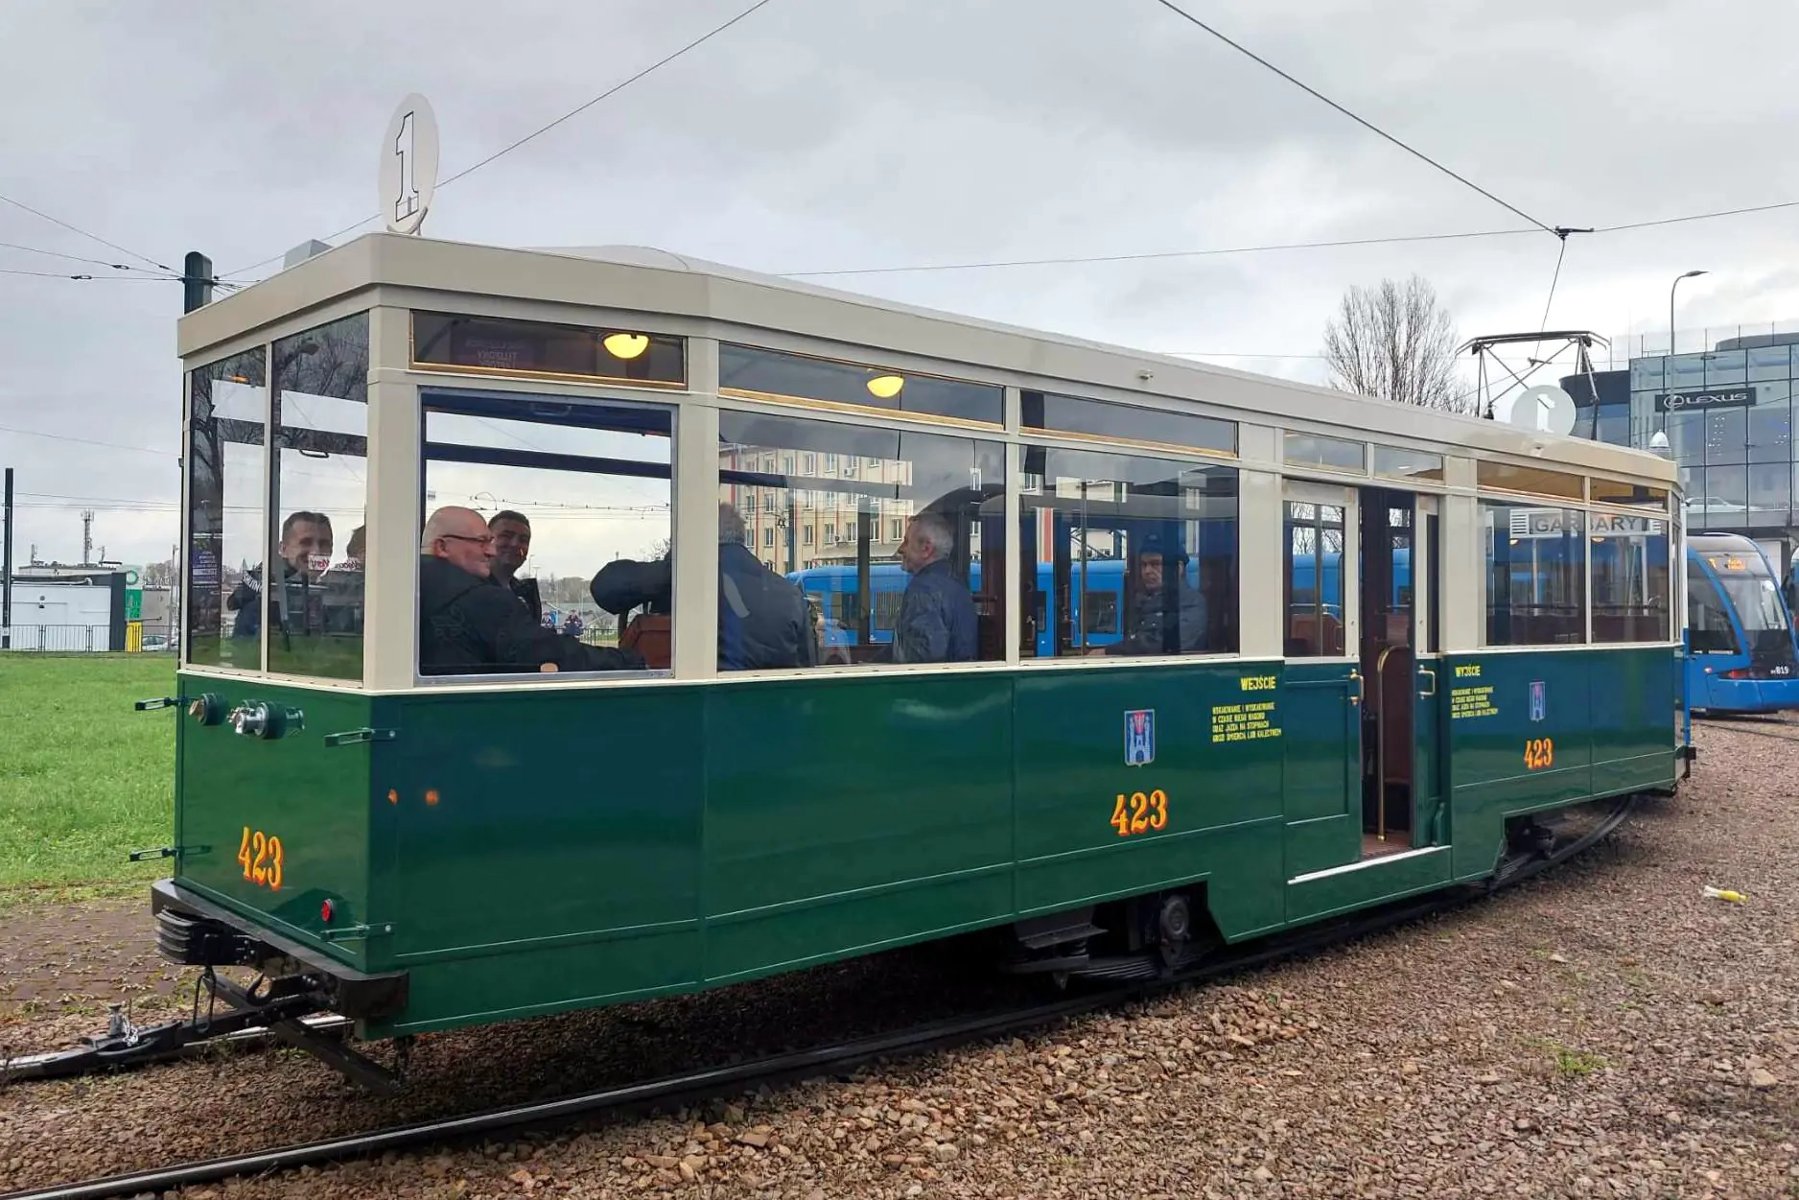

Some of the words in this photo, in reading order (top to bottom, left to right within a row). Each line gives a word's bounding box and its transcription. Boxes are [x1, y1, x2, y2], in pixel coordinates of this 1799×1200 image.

[395, 110, 419, 223] 1
[1686, 392, 1748, 405] LEXUS
[1240, 675, 1277, 691] WEJŚCIE
[1523, 737, 1554, 770] 423
[1110, 789, 1169, 837] 423
[237, 826, 285, 891] 423
